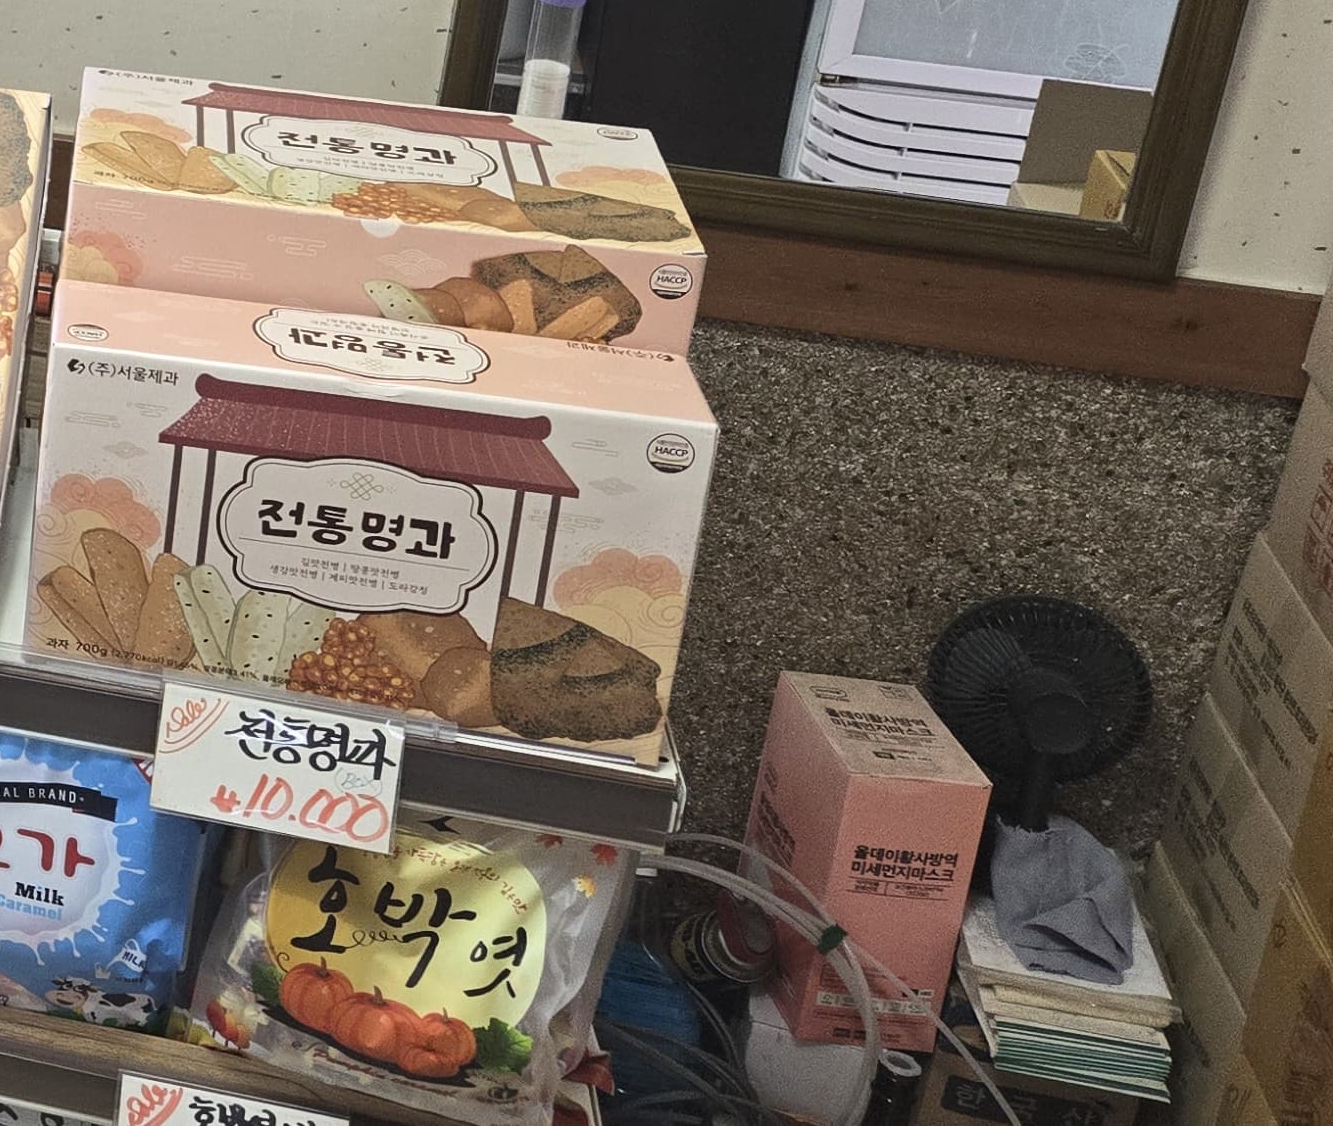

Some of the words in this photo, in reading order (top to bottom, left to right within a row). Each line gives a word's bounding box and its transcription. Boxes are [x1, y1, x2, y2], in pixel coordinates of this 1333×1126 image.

[277, 130, 458, 166] 전통명과
[656, 275, 687, 285] HACCP
[288, 326, 457, 366] 전통명과
[87, 360, 179, 388] (주)서울제과
[654, 446, 689, 458] HACCP
[257, 497, 457, 563] 전통명과
[46, 637, 70, 650] 과자
[75, 641, 108, 658] 700g
[224, 708, 396, 781] 전통명과
[28, 787, 77, 804] BRAND
[854, 844, 959, 868] 올데이황사방역
[851, 861, 955, 882] 미세먼지마스크
[15, 882, 65, 907] Milk
